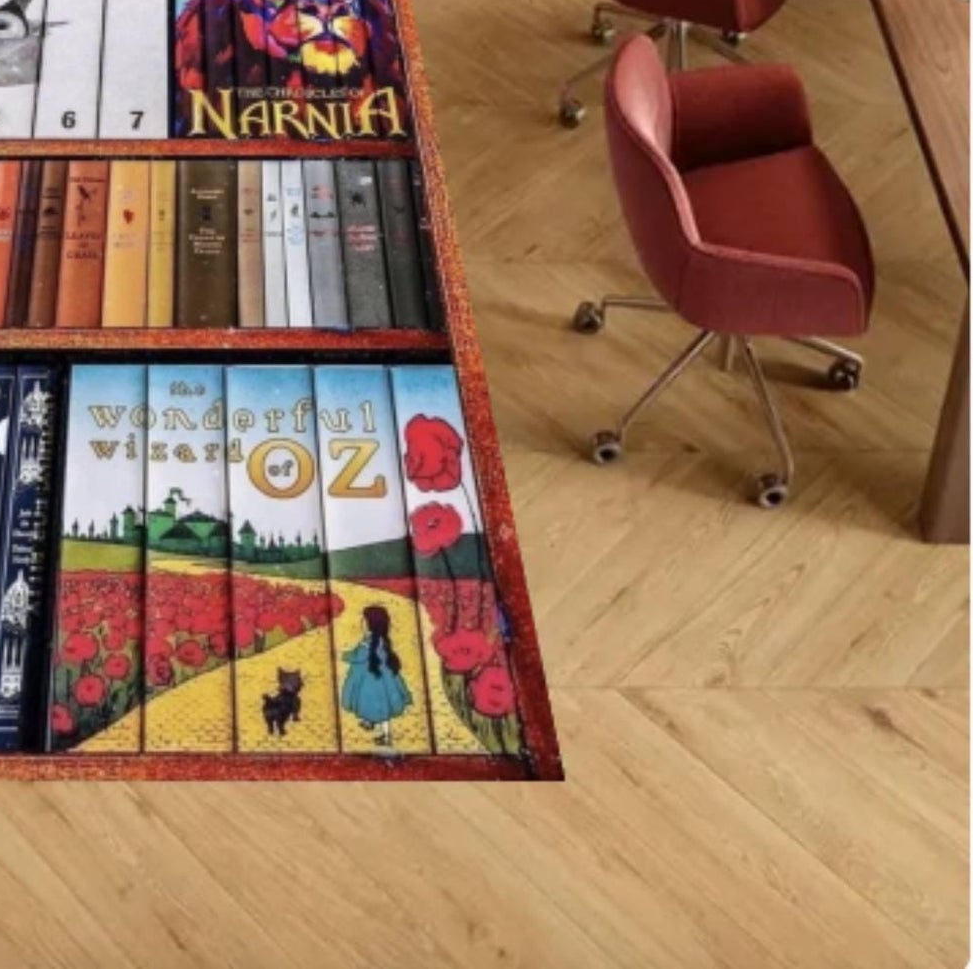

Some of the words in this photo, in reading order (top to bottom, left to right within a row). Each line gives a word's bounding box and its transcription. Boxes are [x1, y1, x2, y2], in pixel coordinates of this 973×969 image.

[60, 110, 77, 129] 6
[128, 110, 145, 129] 7
[186, 86, 408, 141] NARNIA
[169, 380, 206, 396] the
[87, 397, 378, 433] wonderful
[89, 433, 244, 463] wizard
[246, 437, 388, 499] OZ
[267, 460, 294, 477] of
